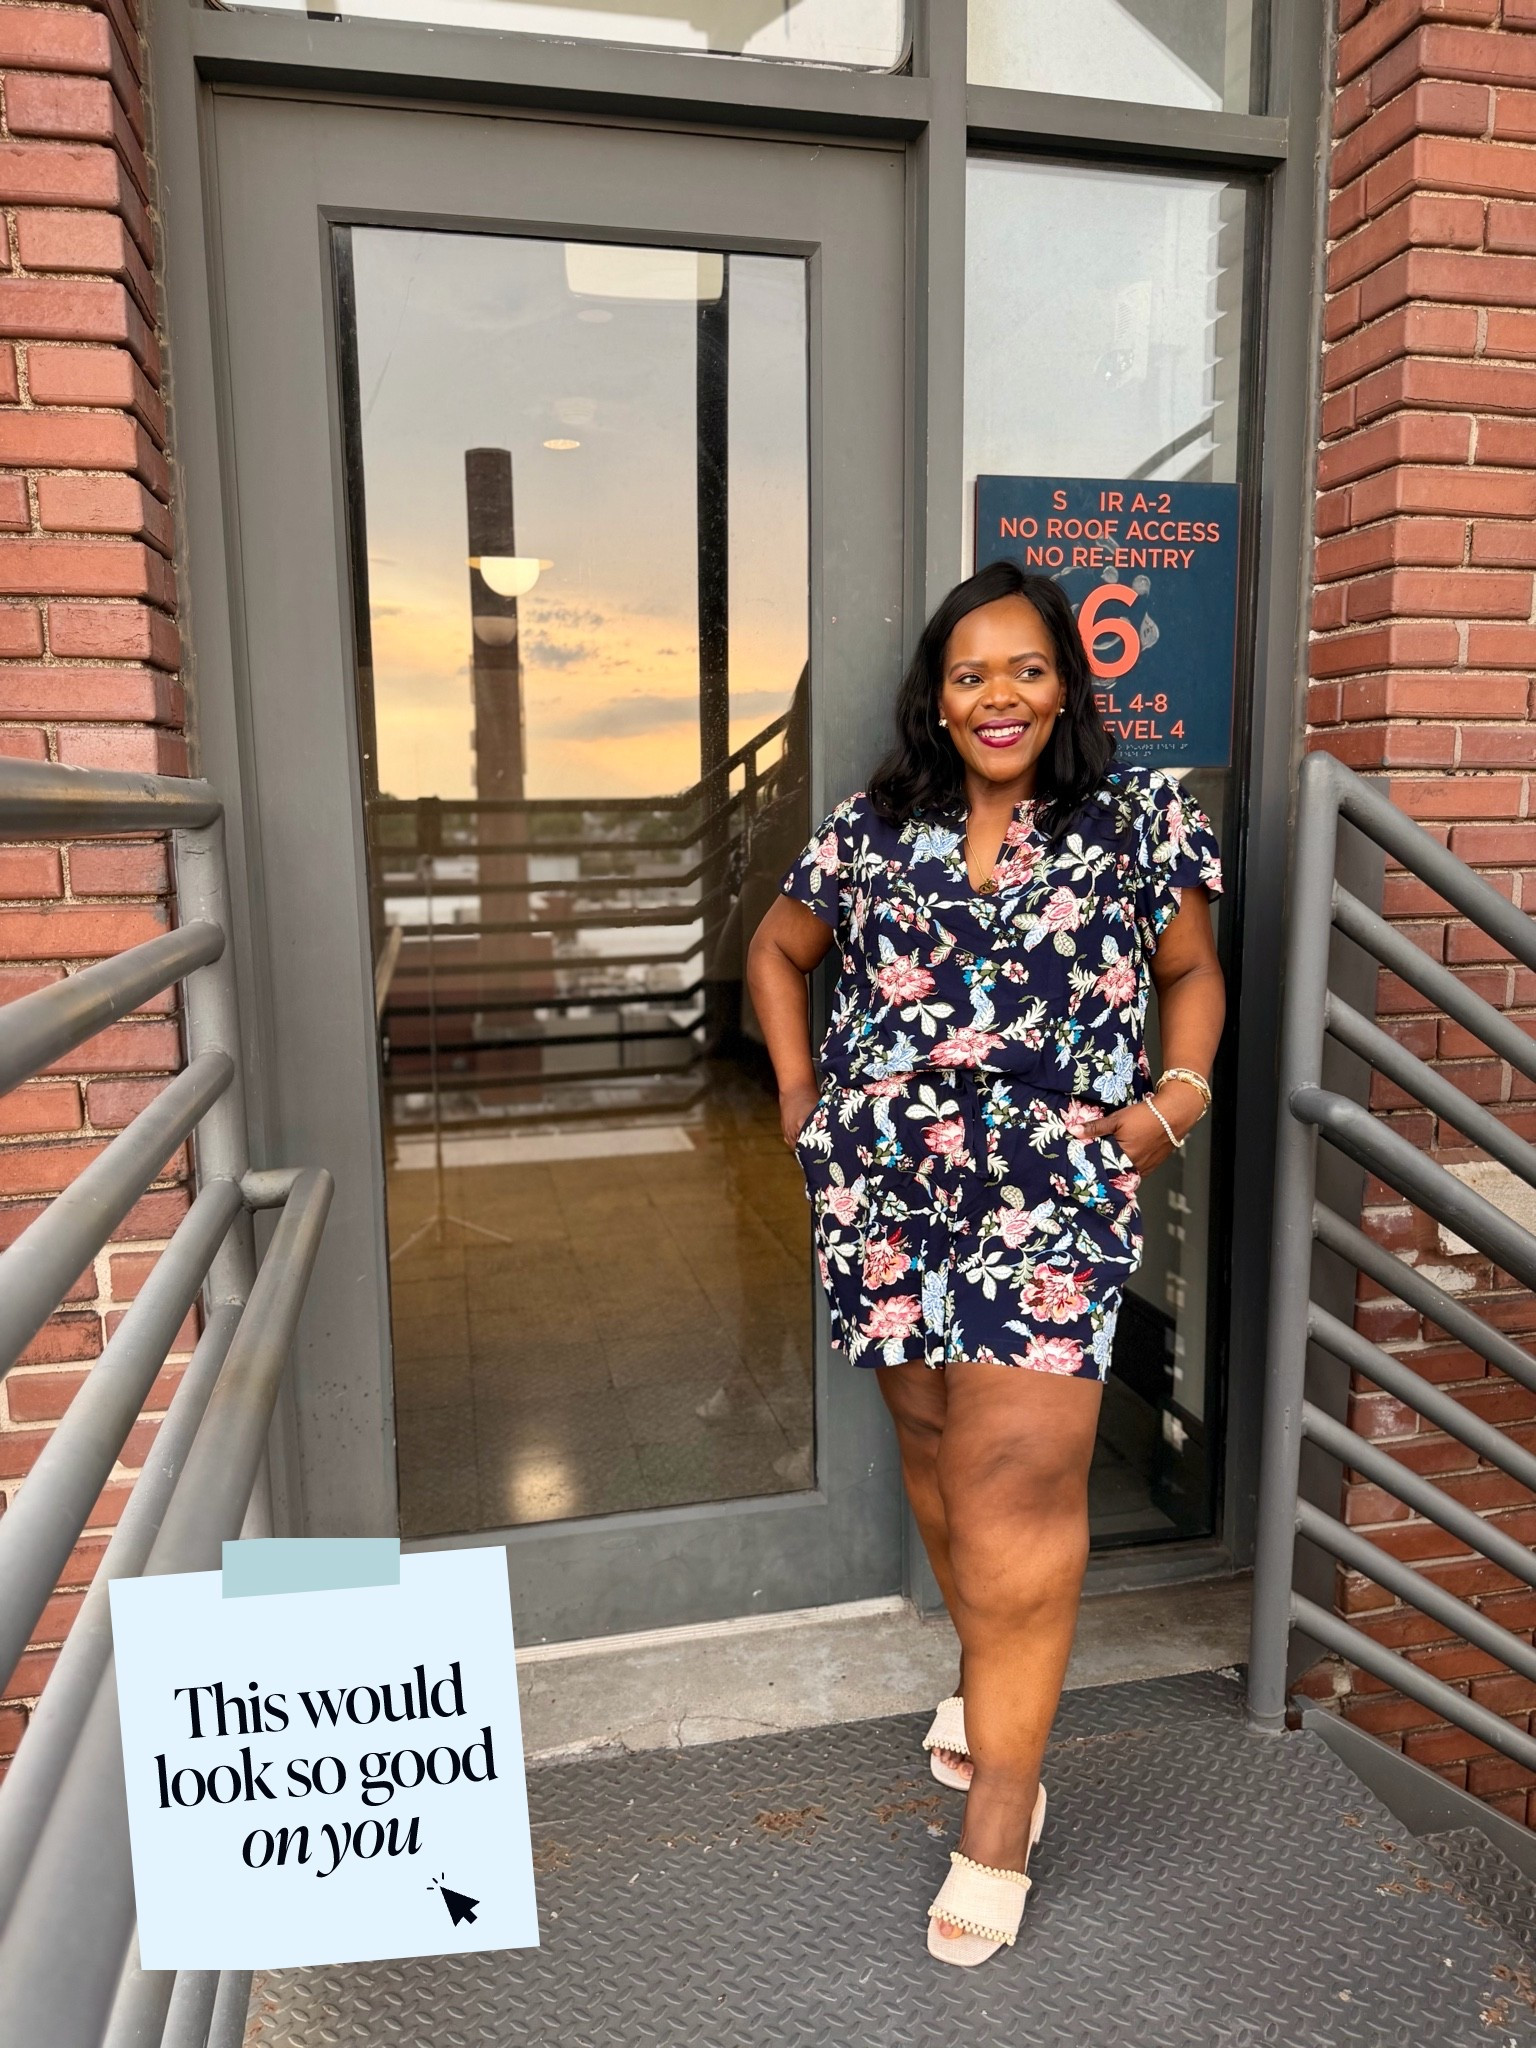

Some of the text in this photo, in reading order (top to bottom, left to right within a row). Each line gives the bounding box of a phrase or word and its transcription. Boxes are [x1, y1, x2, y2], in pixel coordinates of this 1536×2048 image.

[1053, 490, 1068, 511] S
[1130, 492, 1171, 514] A-2
[1000, 517, 1220, 543] NO ROOF ACCESS
[1026, 546, 1194, 568] NO RE-ENTRY
[1077, 581, 1141, 679] 6
[1094, 693, 1168, 713] EL 4-8
[1102, 719, 1185, 740] EVEL 4
